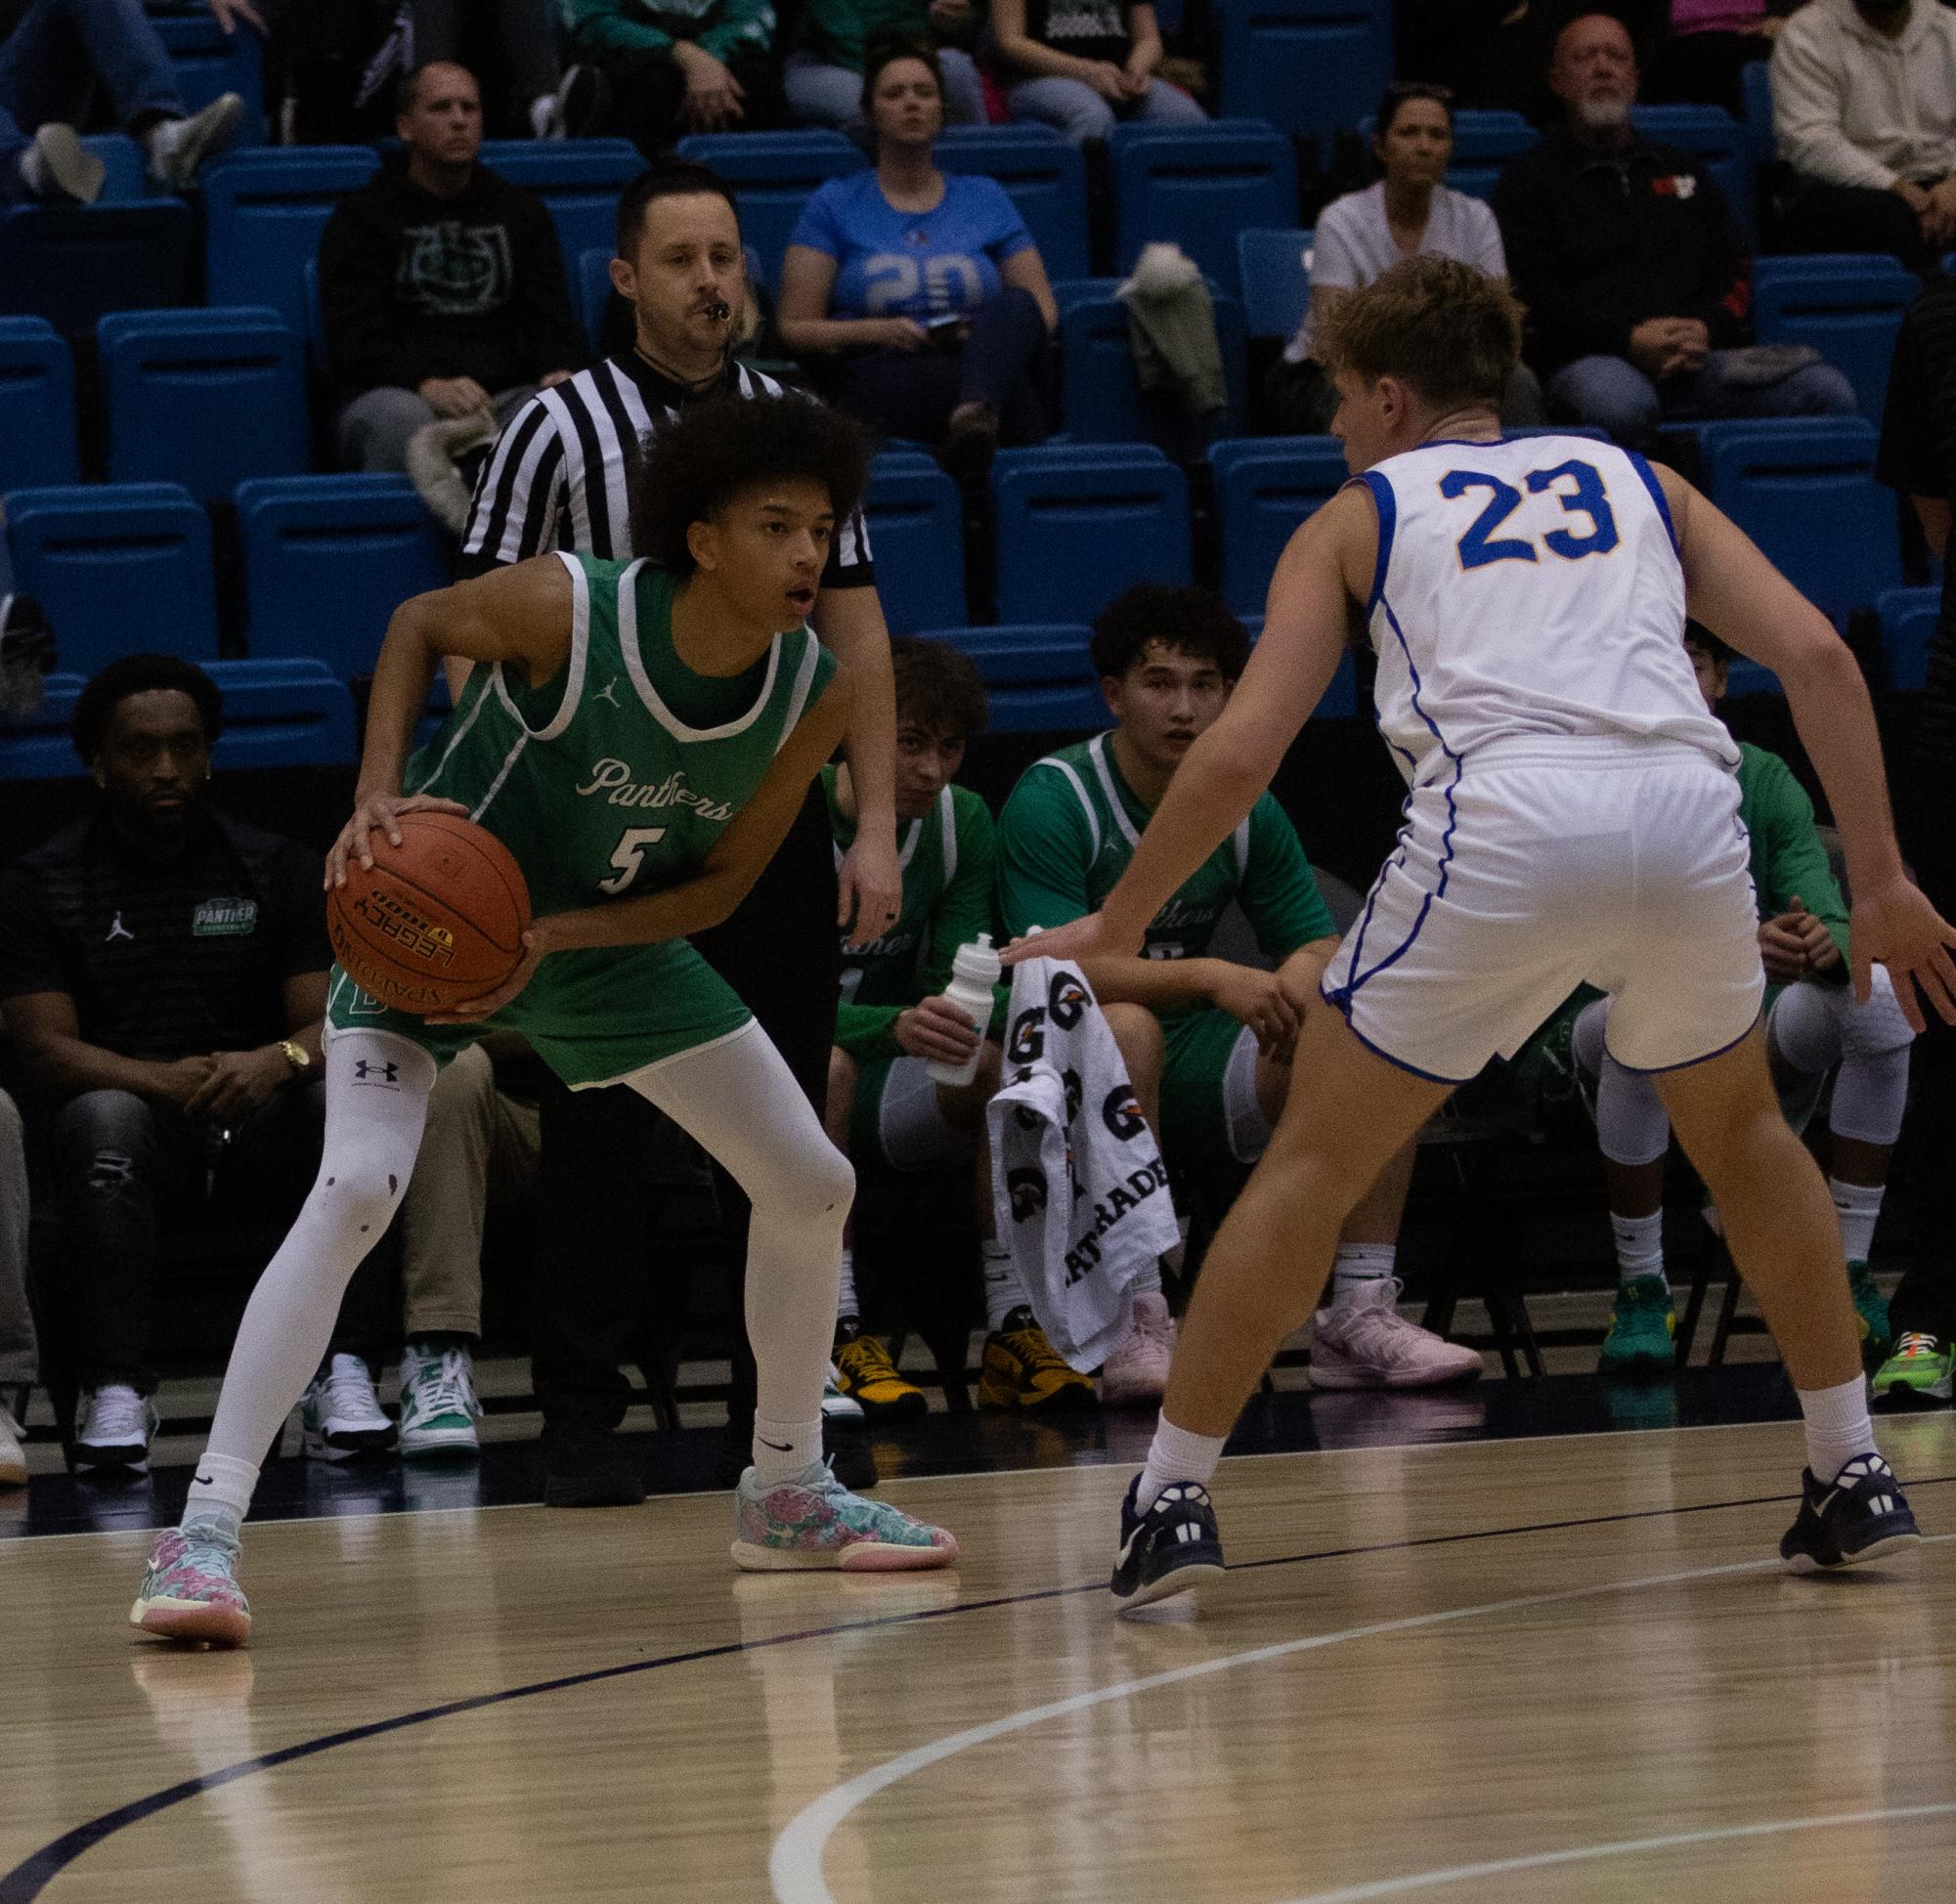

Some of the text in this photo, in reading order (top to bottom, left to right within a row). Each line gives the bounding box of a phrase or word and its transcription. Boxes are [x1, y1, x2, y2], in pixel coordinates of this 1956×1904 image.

[1435, 458, 1623, 574] 23
[575, 757, 735, 821] Panthers
[595, 827, 669, 896] 5
[353, 898, 456, 969] LEGACY
[1049, 971, 1093, 1031] G
[1007, 1006, 1047, 1064] G
[1103, 1084, 1147, 1141] G
